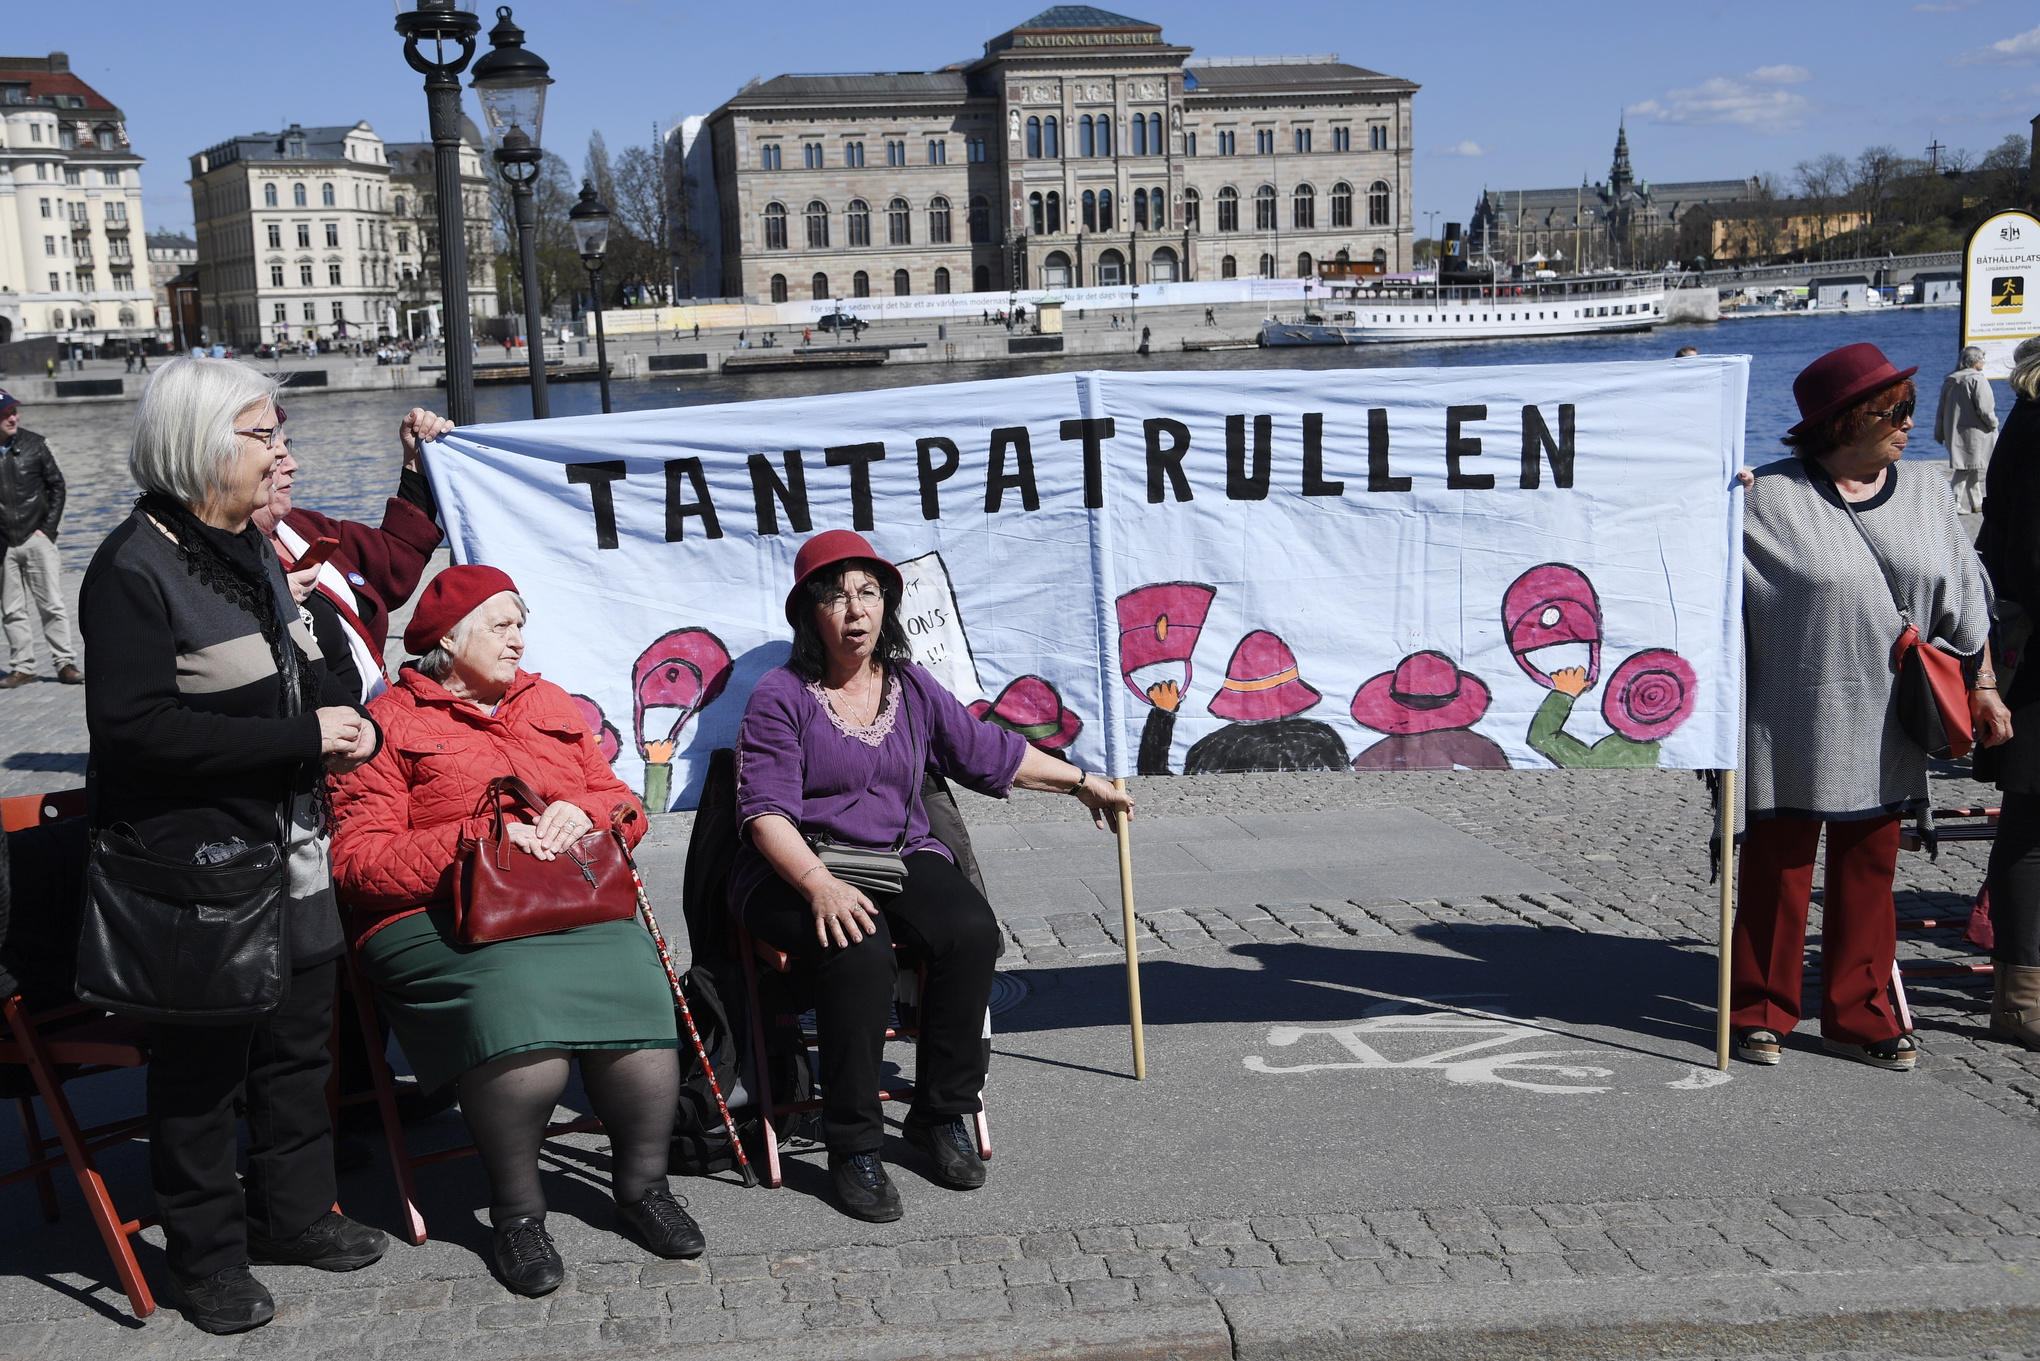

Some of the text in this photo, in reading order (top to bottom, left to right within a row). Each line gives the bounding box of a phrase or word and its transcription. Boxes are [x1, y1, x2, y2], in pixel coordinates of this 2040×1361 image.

[1025, 33, 1153, 47] NATIONALMUSEUM
[1976, 254, 2040, 264] BÅTHÅLLPLATS
[811, 305, 823, 313] För
[849, 302, 871, 311] sedan
[886, 301, 898, 309] det
[900, 301, 911, 309] här
[937, 299, 968, 307] världens
[969, 297, 1010, 306] modernast
[1076, 292, 1084, 300] är
[1086, 291, 1097, 299] det
[1099, 290, 1116, 301] dags
[565, 403, 1576, 550] TANTPATRULLEN
